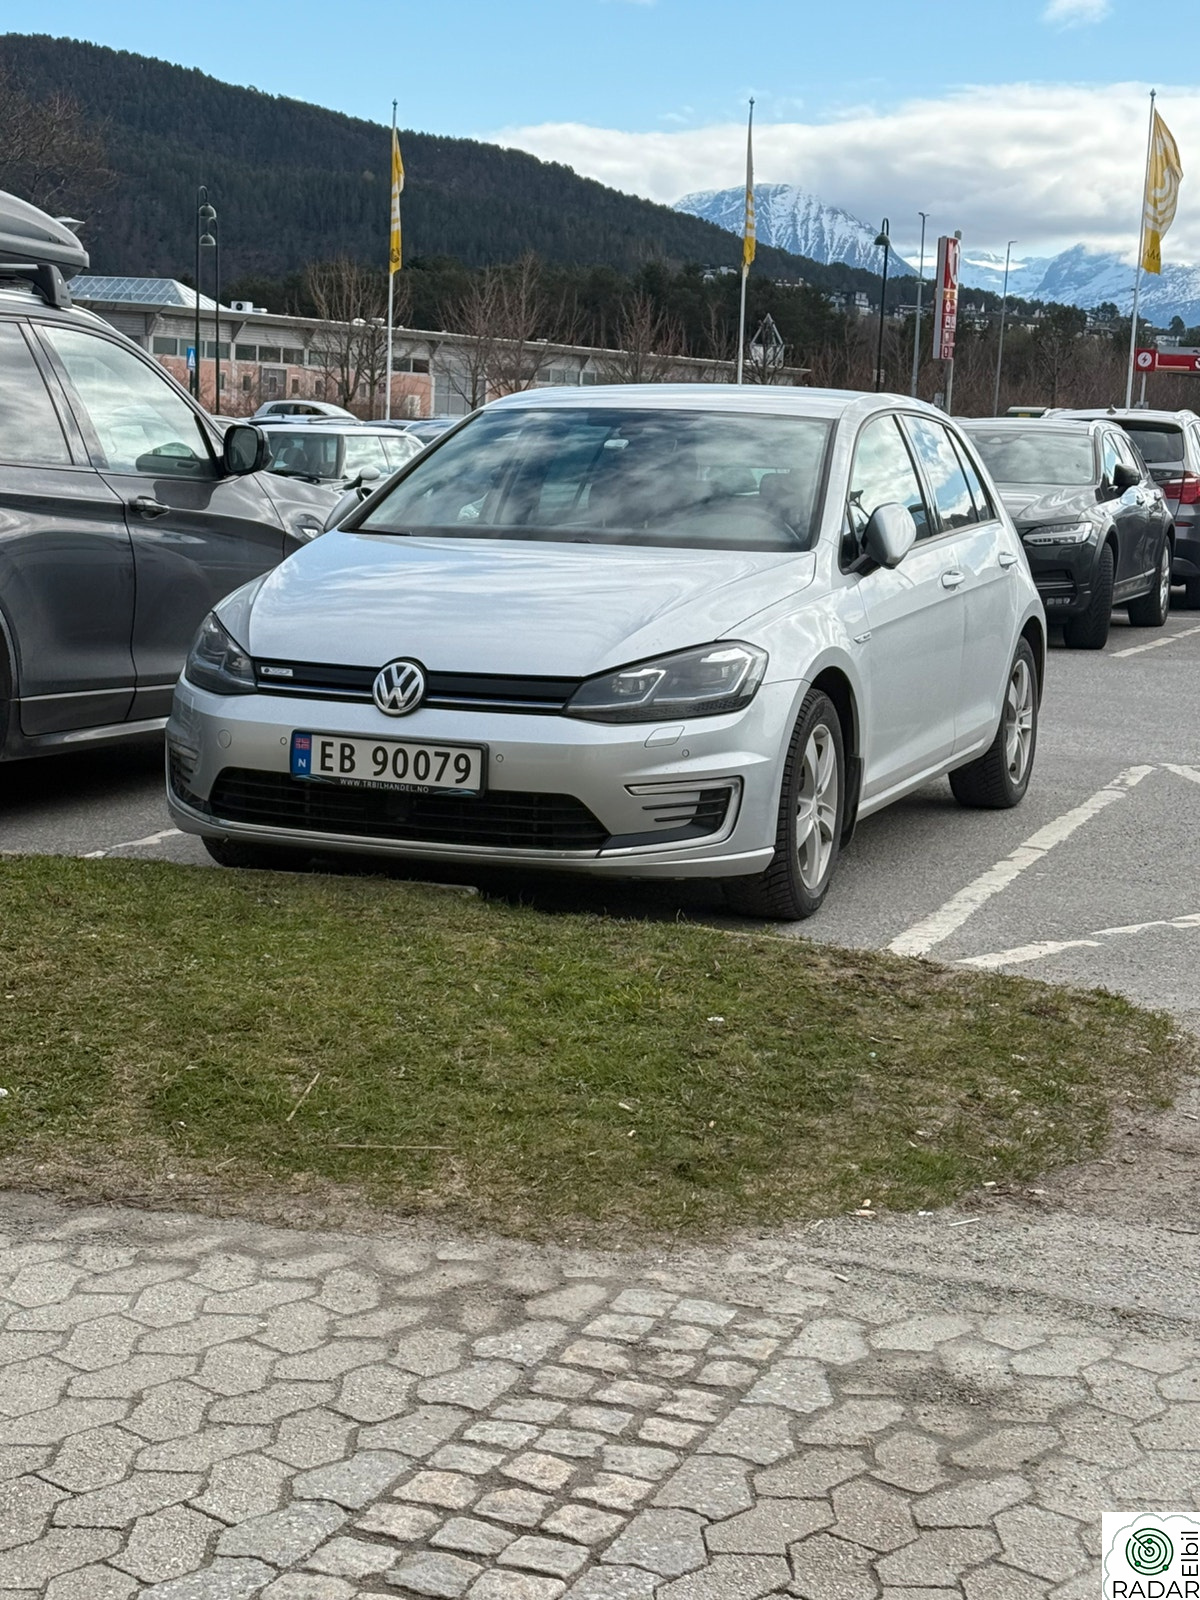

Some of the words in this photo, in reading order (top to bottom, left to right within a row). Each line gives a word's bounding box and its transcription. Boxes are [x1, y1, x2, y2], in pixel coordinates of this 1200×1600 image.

[297, 758, 307, 768] N
[320, 741, 356, 773] EB
[371, 746, 472, 784] 90079
[339, 778, 429, 793] WWW.TRBILHANDEL.NO
